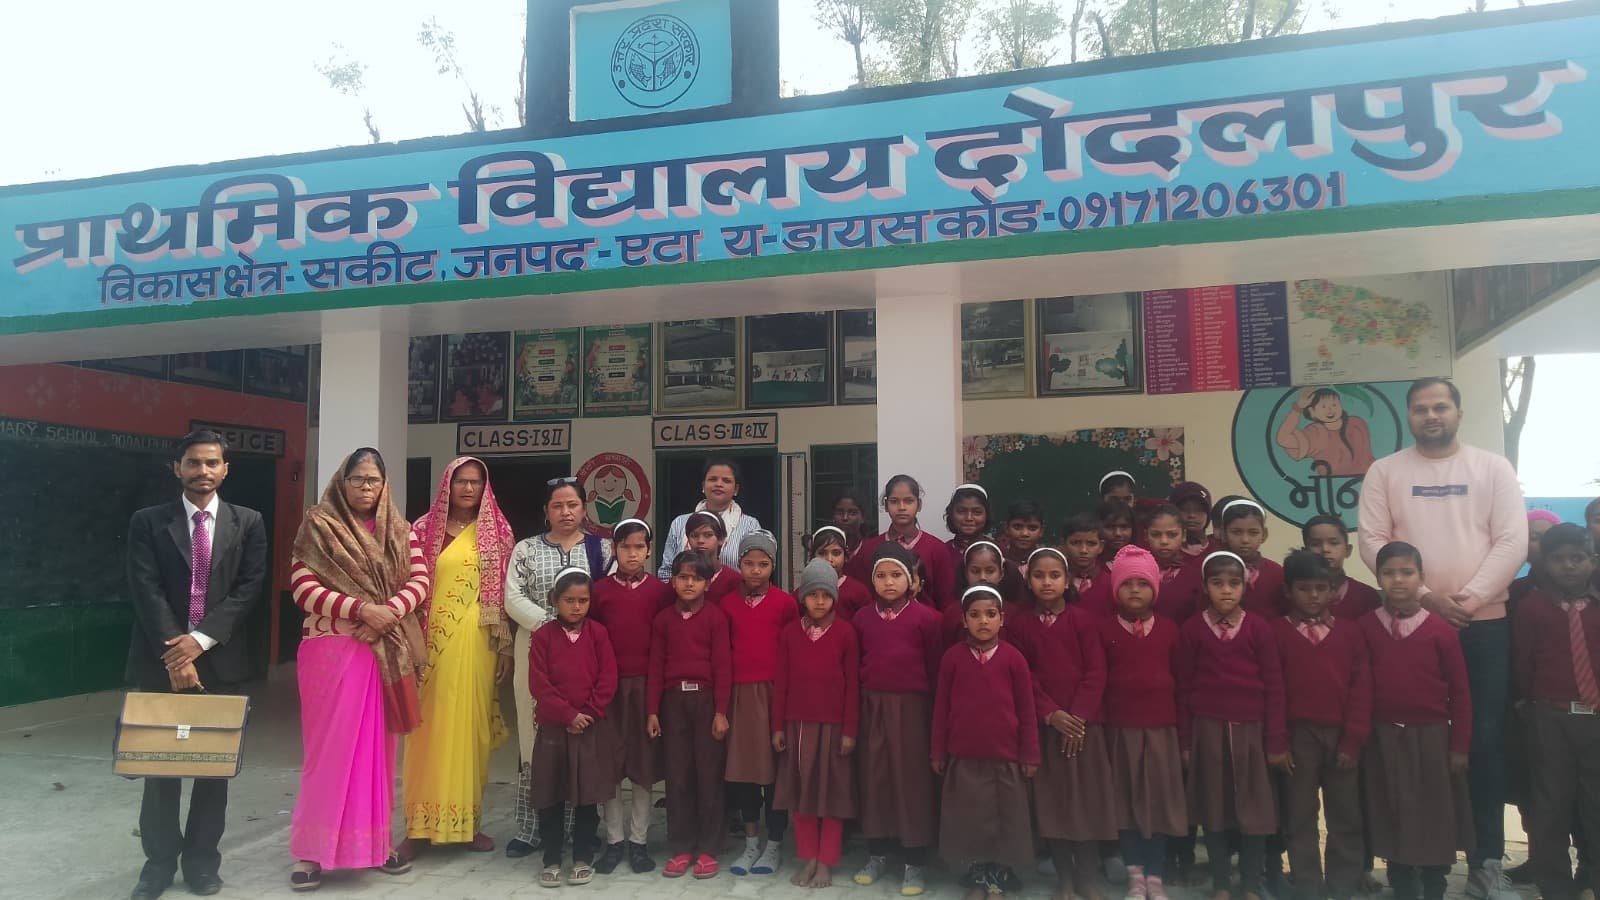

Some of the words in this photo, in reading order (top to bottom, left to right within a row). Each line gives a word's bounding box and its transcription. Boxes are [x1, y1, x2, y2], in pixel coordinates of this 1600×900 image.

[14, 174, 441, 275] प्राथमिक
[447, 135, 919, 233] विद्यालय
[926, 59, 1587, 197] दोदलपुर
[97, 264, 223, 304] विकास
